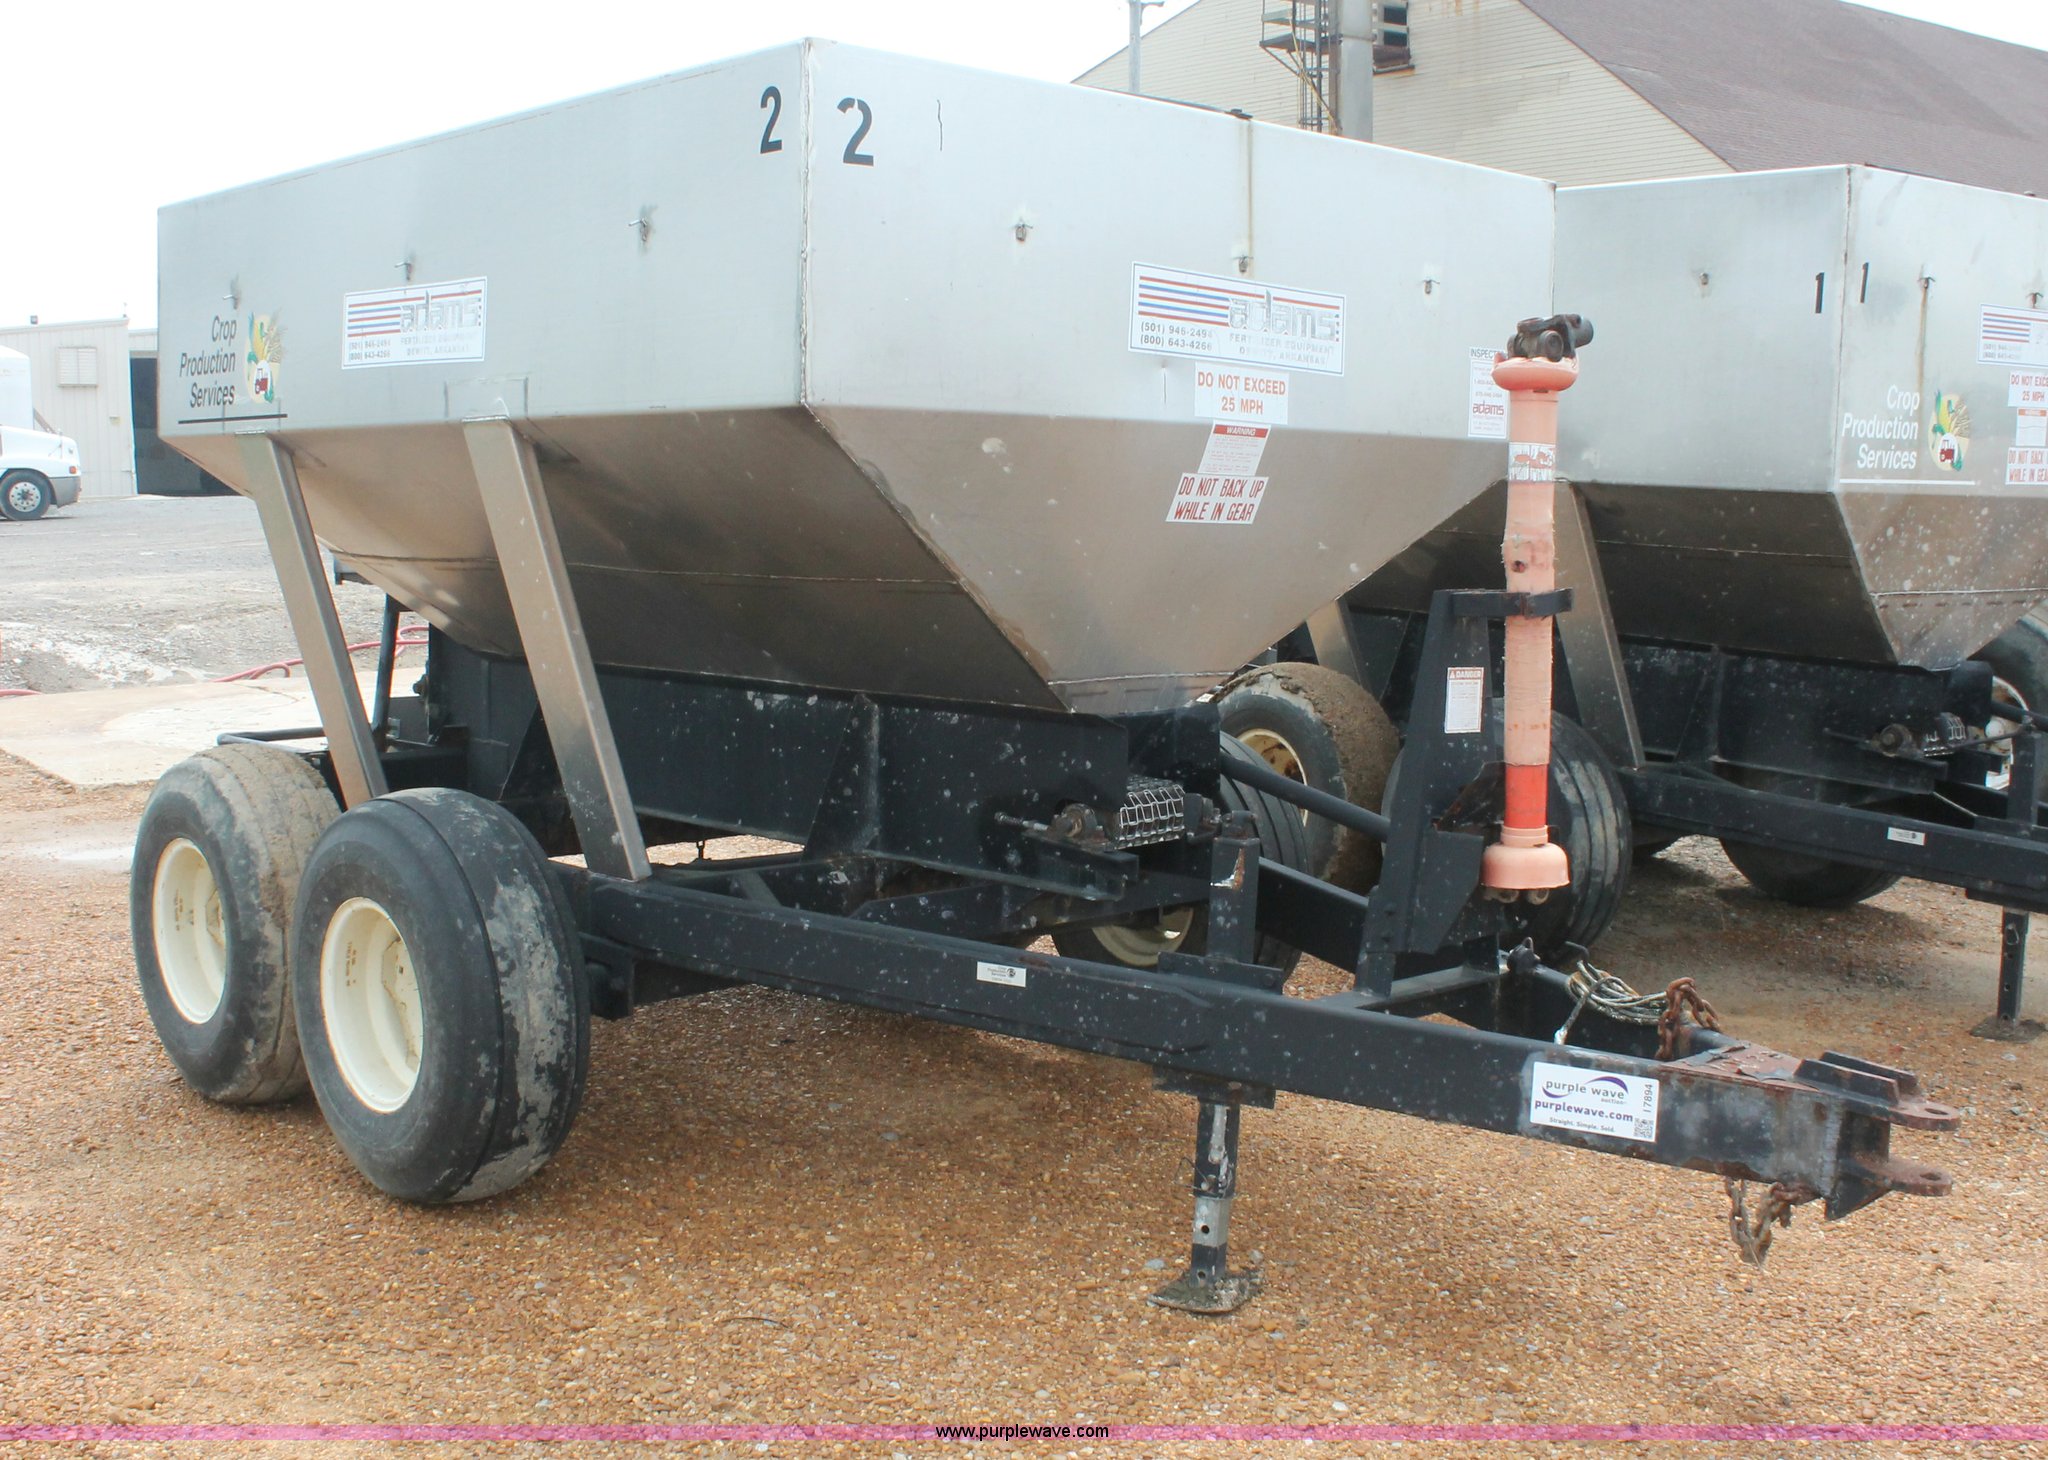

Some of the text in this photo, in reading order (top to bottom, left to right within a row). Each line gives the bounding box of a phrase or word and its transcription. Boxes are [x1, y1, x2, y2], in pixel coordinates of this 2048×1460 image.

[760, 86, 782, 154] 2
[837, 97, 874, 166] 2
[1815, 272, 1825, 314] 1
[1860, 262, 1869, 304] 1
[212, 315, 237, 346] Crop
[1141, 321, 1165, 336] (501)
[1140, 334, 1164, 348] (800)
[179, 348, 236, 377] Production
[1197, 371, 1286, 396] DO NOT EXCEED
[2010, 374, 2020, 385] DO
[2021, 375, 2033, 386] NOT
[190, 380, 235, 408] Services
[1221, 396, 1264, 415] 25 MPH
[1887, 384, 1920, 416] Crop
[2022, 390, 2030, 401] 25
[1472, 400, 1505, 416] adams
[1226, 427, 1257, 436] WARNING
[1841, 412, 1919, 440] Production
[1857, 443, 1917, 470] Services
[1178, 477, 1265, 498] DO NOT BACK UP
[1173, 502, 1255, 521] WHILE IN GEAR
[1546, 1081, 1625, 1100] purple wave
[1534, 1100, 1634, 1122] purplewave.com
